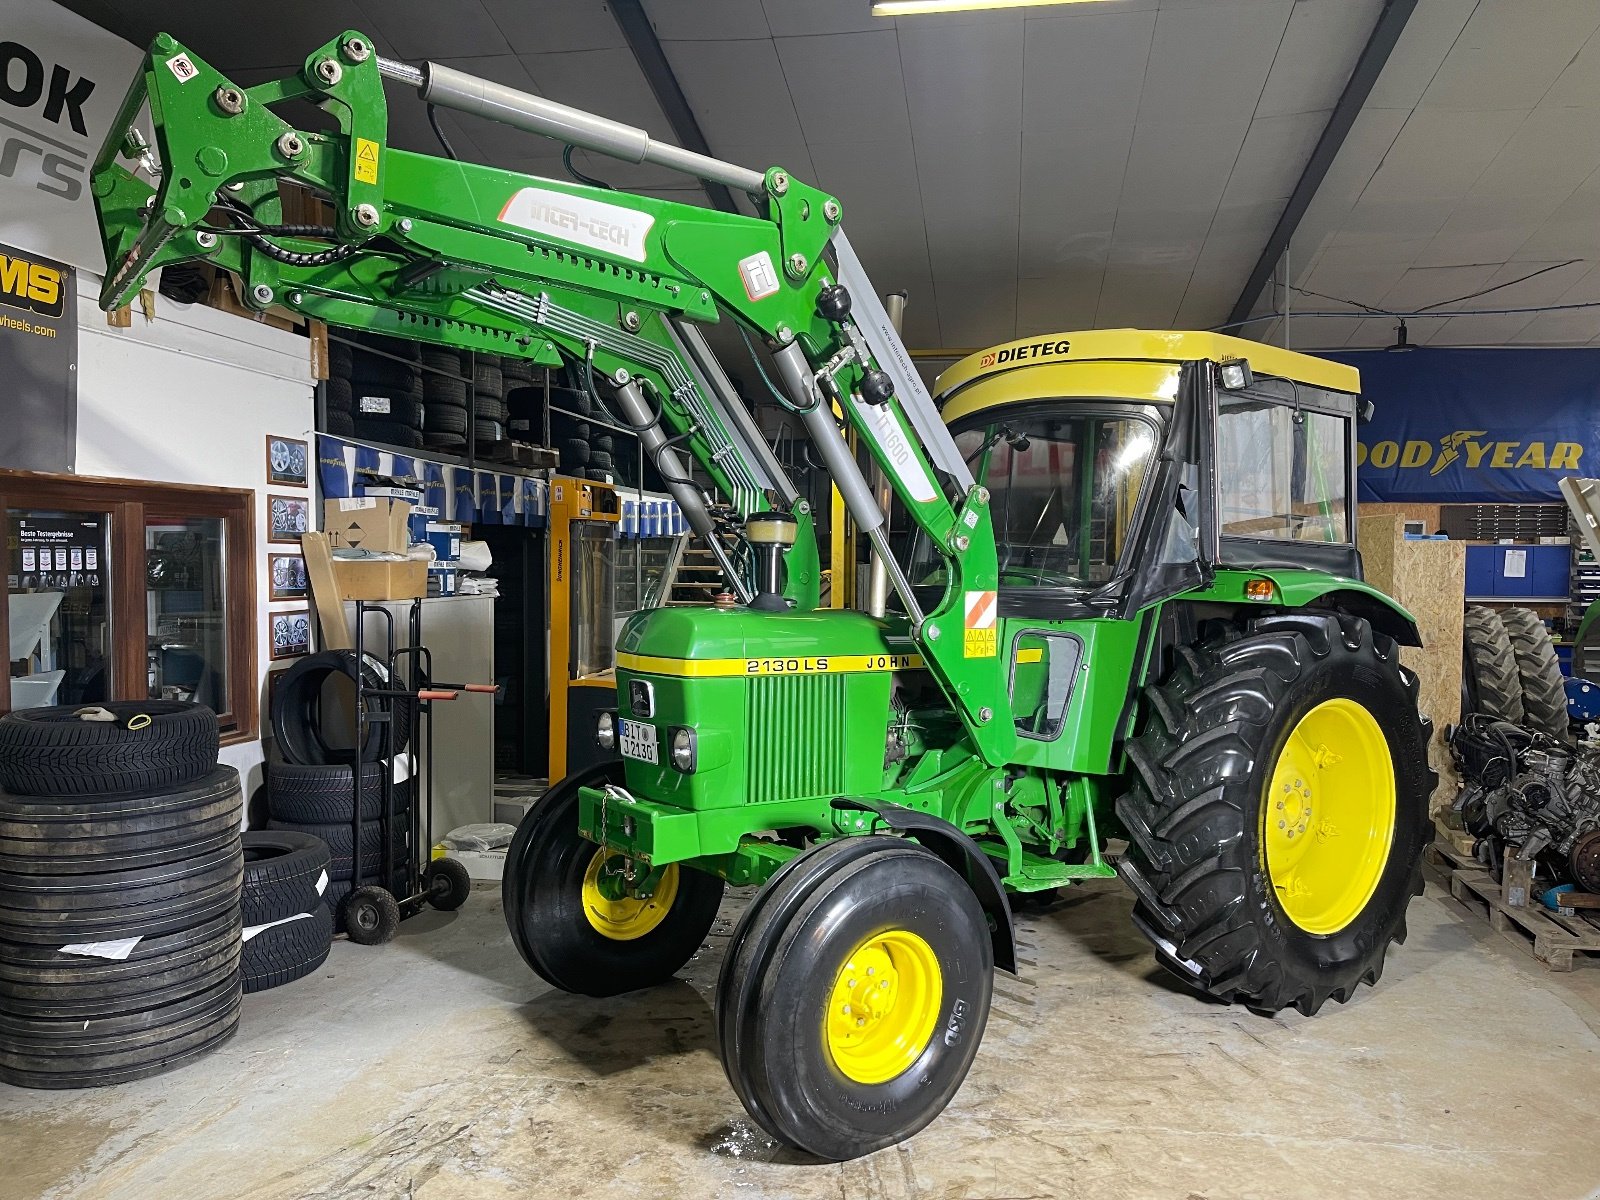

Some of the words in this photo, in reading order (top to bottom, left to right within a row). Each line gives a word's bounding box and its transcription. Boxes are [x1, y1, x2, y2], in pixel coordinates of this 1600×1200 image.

[0, 41, 96, 137] OK
[881, 324, 922, 395] www.intertech-agro.pl
[997, 340, 1071, 364] DIETEG
[875, 413, 891, 431] IT
[884, 428, 909, 466] 1600
[37, 531, 74, 539] Testergebnisse
[748, 659, 799, 673] 2130
[804, 658, 829, 671] LS
[866, 656, 910, 669] JOHN
[624, 722, 641, 741] BIT
[624, 739, 630, 755] J
[630, 742, 653, 761] 2130
